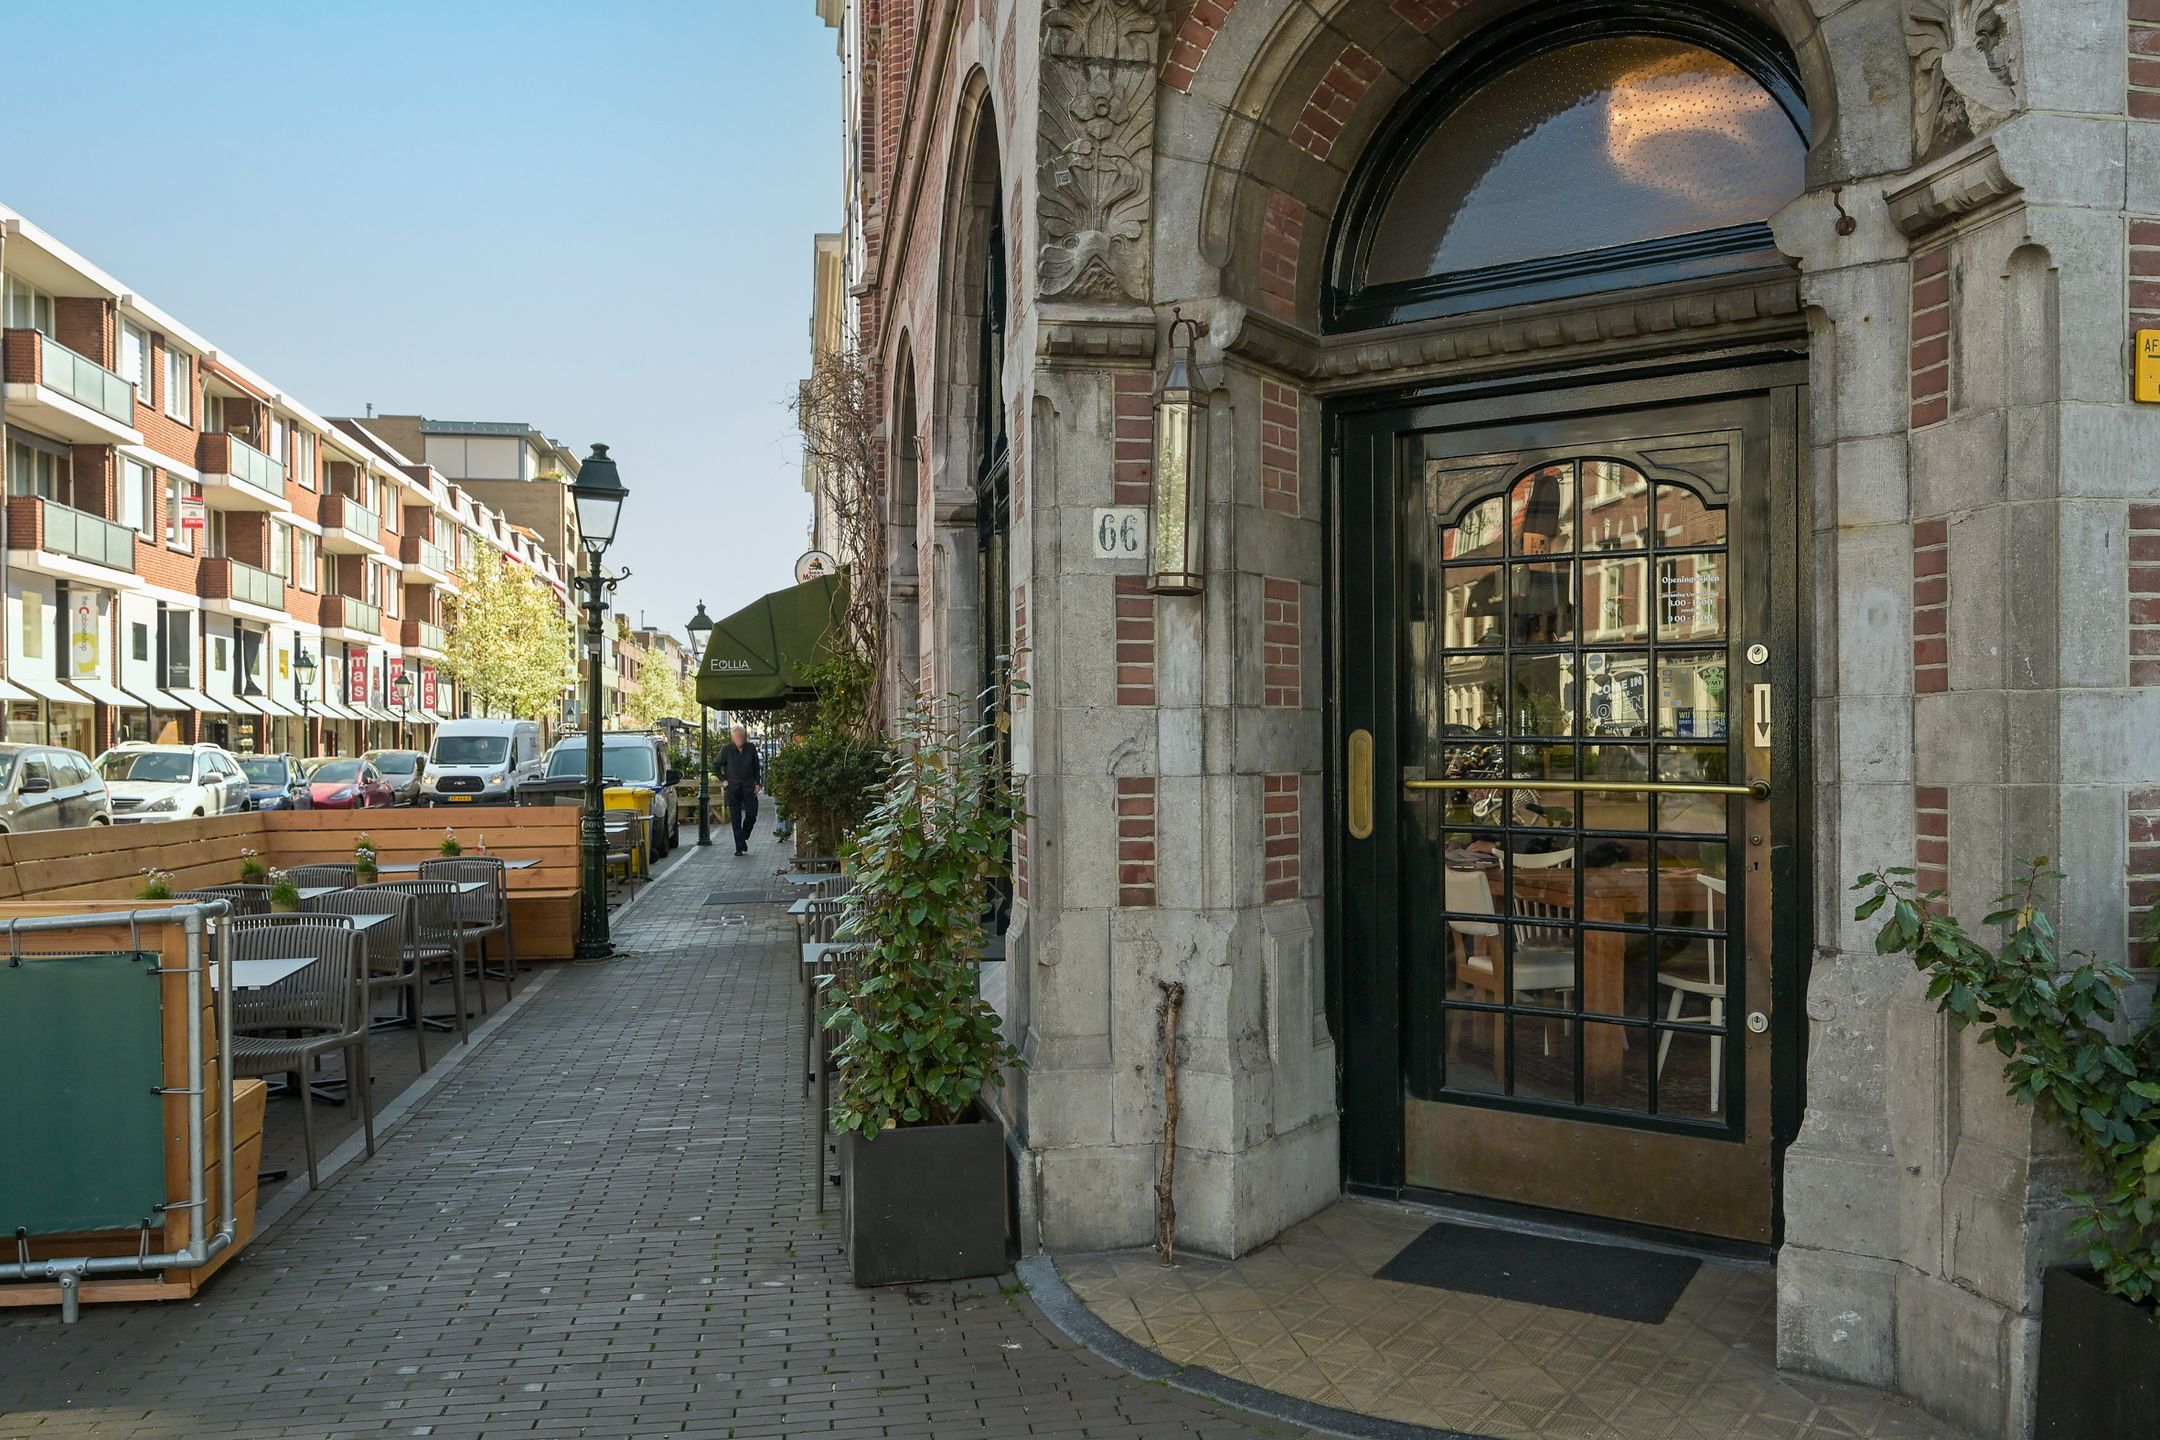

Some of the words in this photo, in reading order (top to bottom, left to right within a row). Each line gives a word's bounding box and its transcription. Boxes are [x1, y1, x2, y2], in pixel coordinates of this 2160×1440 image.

[1098, 514, 1138, 552] 66
[1662, 575, 1720, 584] Openingsijden
[1668, 615, 1687, 623] 900
[710, 658, 751, 672] FOLLIA
[351, 655, 367, 698] mas
[1595, 680, 1628, 696] COE
[1630, 675, 1643, 688] IN
[423, 670, 437, 705] mas
[1597, 695, 1645, 721] OEN
[1692, 711, 1726, 719] VKOPEN
